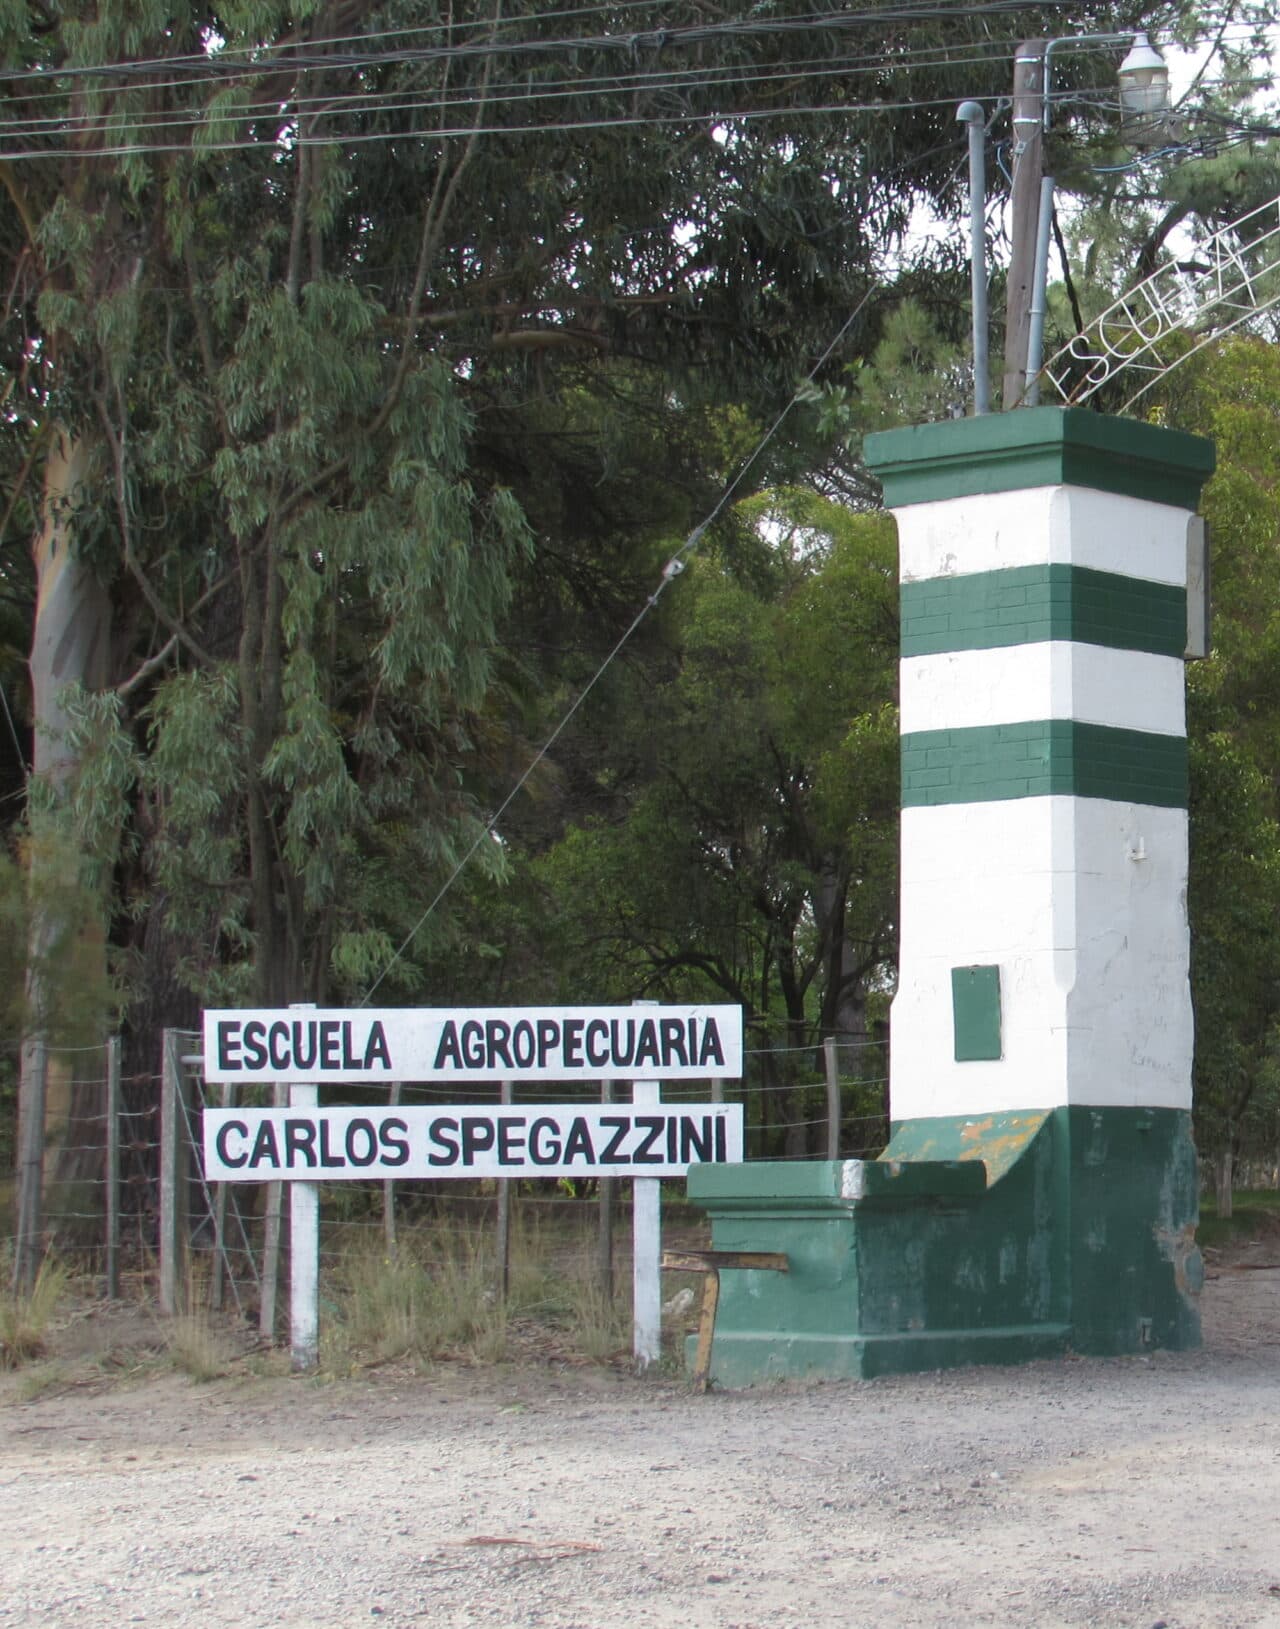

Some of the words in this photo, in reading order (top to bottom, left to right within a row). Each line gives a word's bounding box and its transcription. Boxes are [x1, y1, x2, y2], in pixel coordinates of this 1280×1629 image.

[1046, 234, 1252, 403] ESCUELA
[217, 1020, 392, 1071] ESCUELA
[433, 1017, 725, 1070] AGROPECUARIA
[215, 1117, 410, 1169] CARLOS
[427, 1114, 727, 1168] SPEGAZZINI
